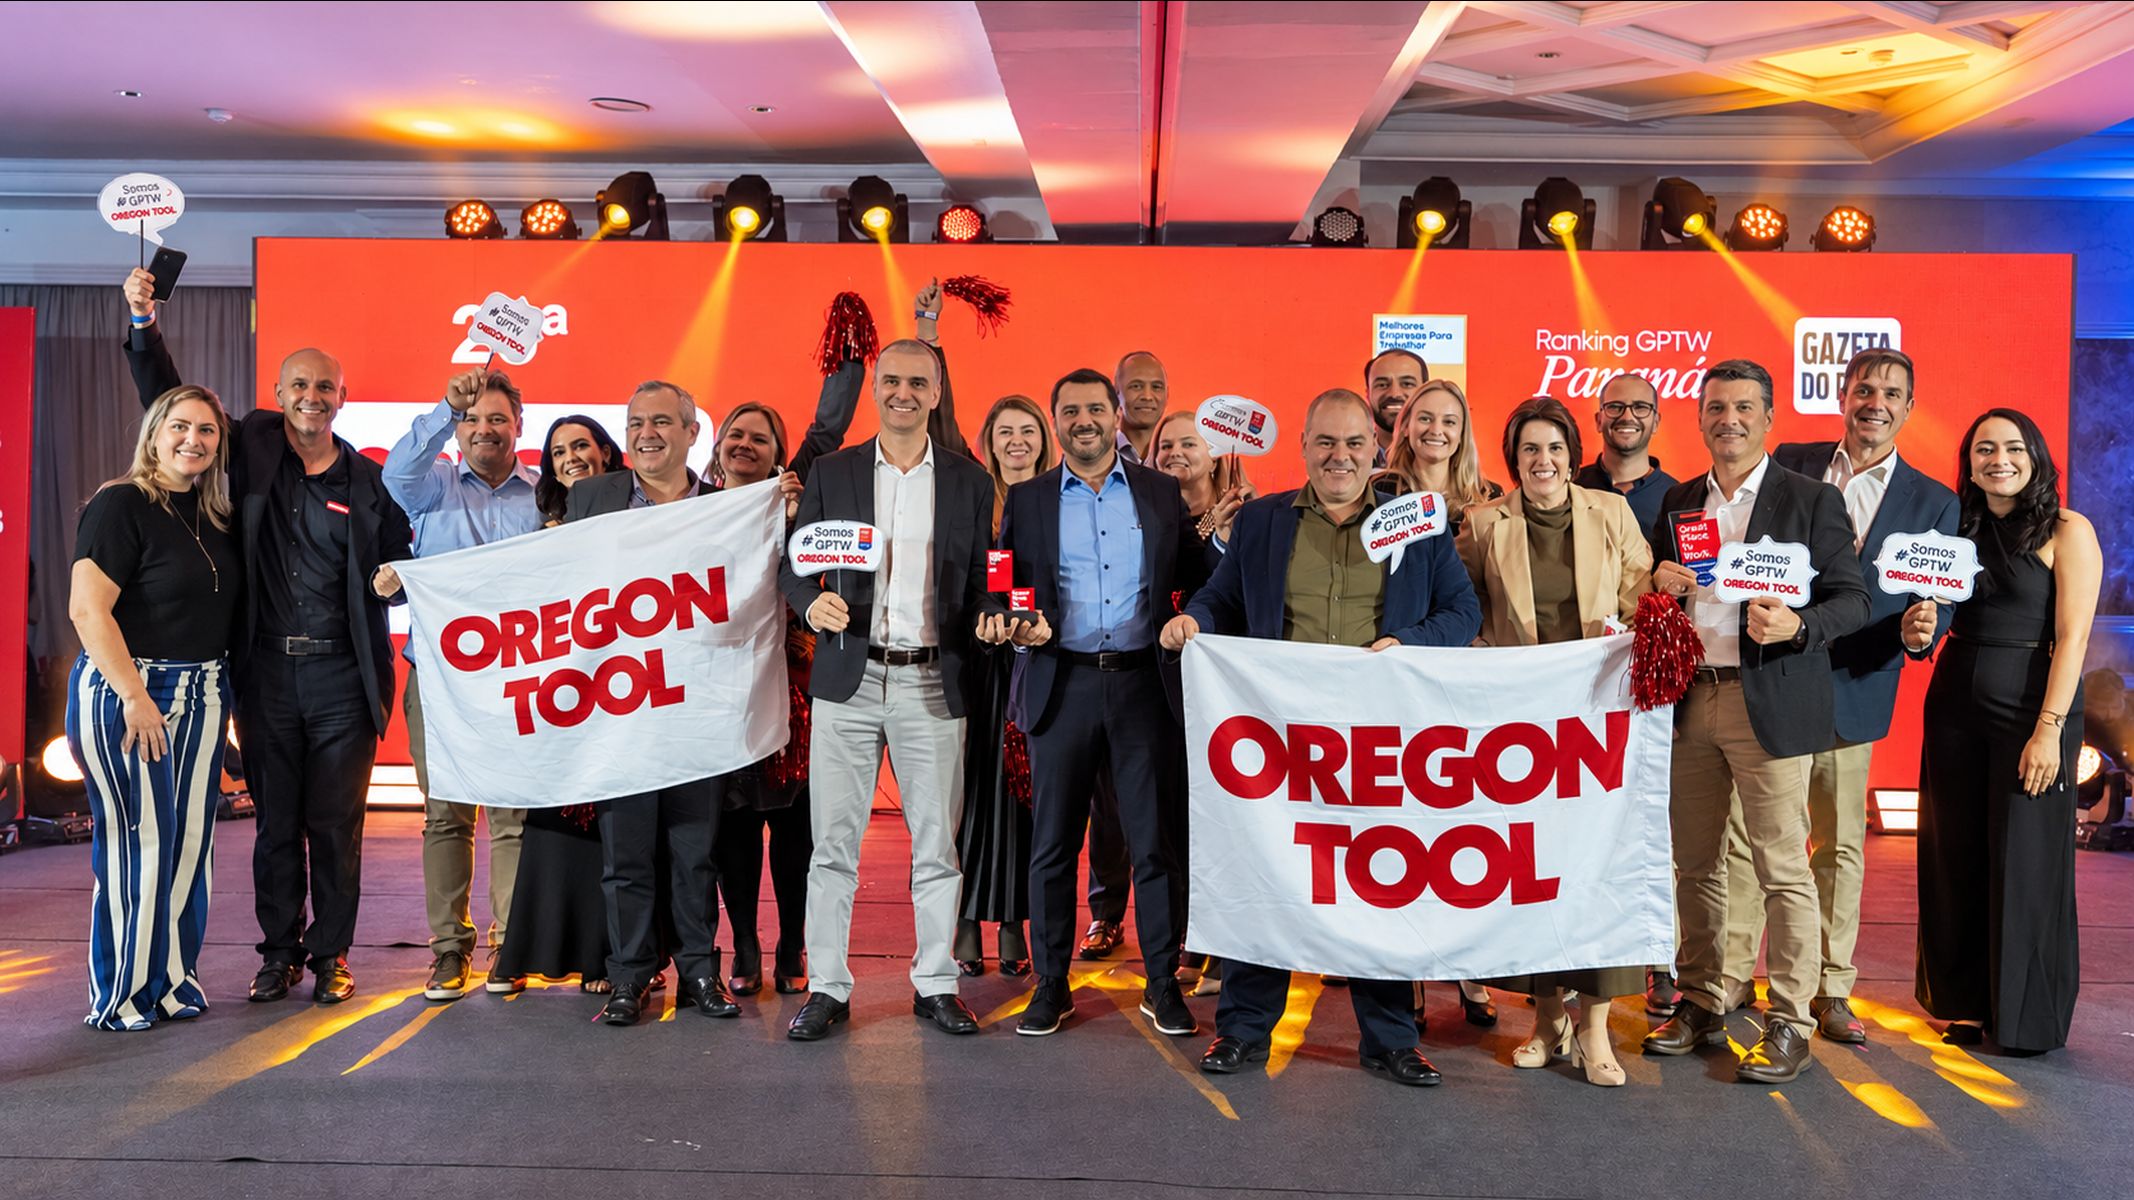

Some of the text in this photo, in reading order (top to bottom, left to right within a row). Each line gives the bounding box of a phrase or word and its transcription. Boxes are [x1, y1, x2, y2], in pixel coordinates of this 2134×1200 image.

[122, 183, 160, 195] Somos
[128, 193, 162, 206] GPTW
[152, 206, 177, 216] TOOL
[1379, 321, 1425, 330] Melhores
[1536, 329, 1712, 357] Ranking GPTW
[1532, 355, 1707, 399] Parná
[1801, 371, 1830, 400] DO
[1241, 432, 1265, 449] TOOL
[1380, 500, 1418, 520] Somos
[1384, 511, 1418, 532] GPTW
[1410, 521, 1435, 536] TOOL
[814, 526, 854, 538] Somos
[815, 539, 852, 551] GPTW
[1910, 542, 1956, 559] Somos
[842, 554, 867, 564] TOOL
[1745, 549, 1791, 565] Somos
[1909, 557, 1952, 572] GPTW
[1745, 564, 1787, 579] GPTW
[1886, 570, 1964, 589] OREGON TOOL
[1723, 578, 1770, 591] OREGON
[1772, 583, 1801, 595] TOOL
[440, 565, 729, 672] OREGON
[503, 648, 685, 736] TOOL
[1207, 710, 1630, 809] OREGON
[1294, 822, 1560, 909] TOOL
